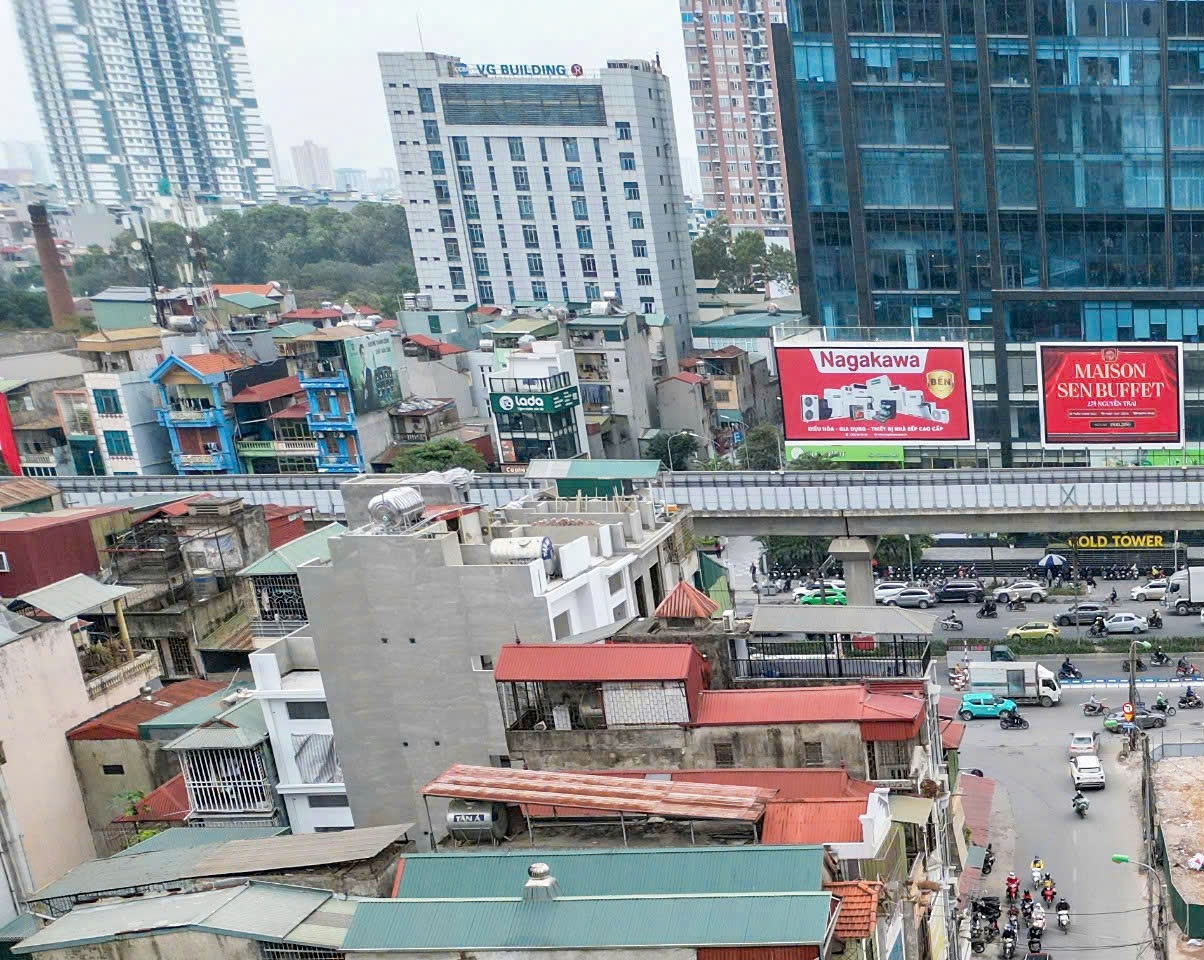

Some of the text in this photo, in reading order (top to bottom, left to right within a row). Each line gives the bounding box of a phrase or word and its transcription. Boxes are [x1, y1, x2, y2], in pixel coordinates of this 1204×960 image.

[477, 64, 496, 75] VG
[500, 64, 566, 75] BUILDING
[820, 351, 920, 371] Nagakawa
[1075, 362, 1146, 379] MAISON
[1057, 382, 1165, 398] SEN BUFFET
[1112, 535, 1163, 547] TOWER
